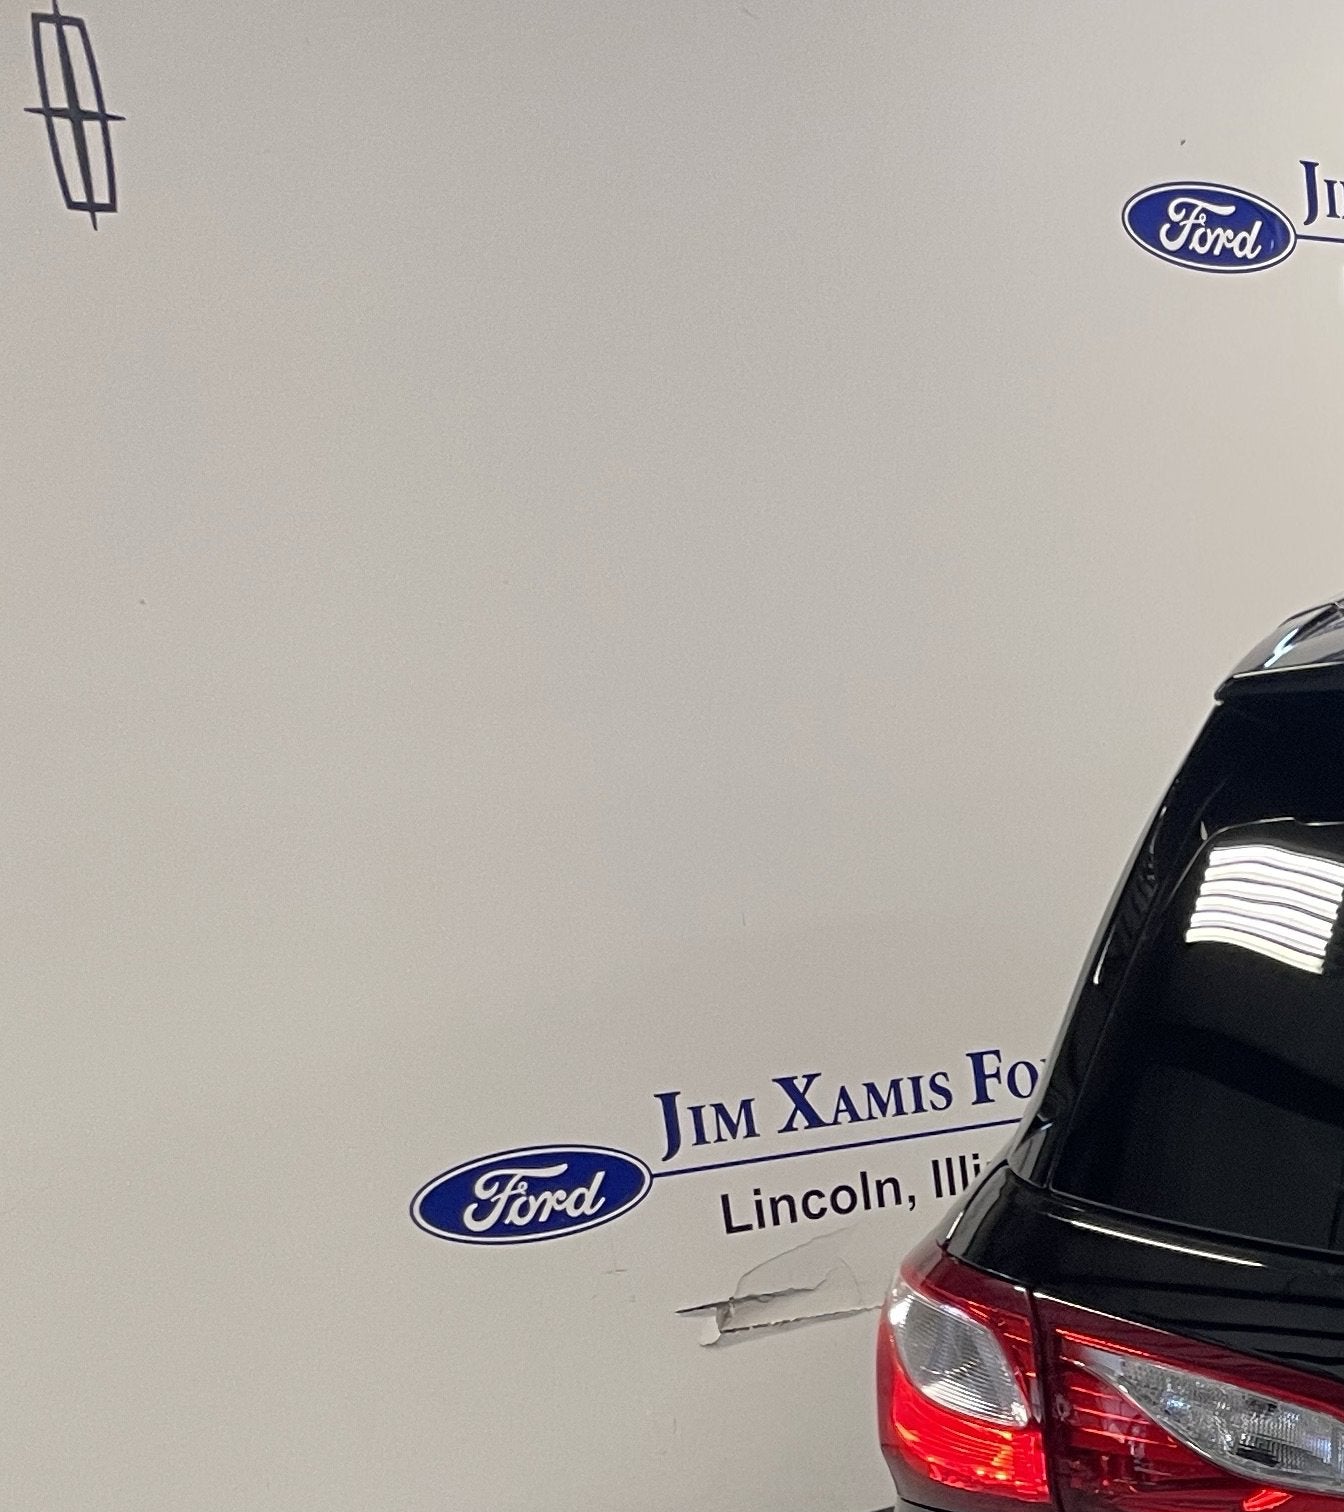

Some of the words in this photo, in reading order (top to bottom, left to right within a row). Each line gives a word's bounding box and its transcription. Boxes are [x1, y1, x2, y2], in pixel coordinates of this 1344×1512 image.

[1159, 197, 1262, 260] Ford
[653, 1090, 761, 1162] JIM
[771, 1070, 954, 1134] XAMIS
[462, 1163, 606, 1232] Ford
[720, 1170, 916, 1235] Lincoln,
